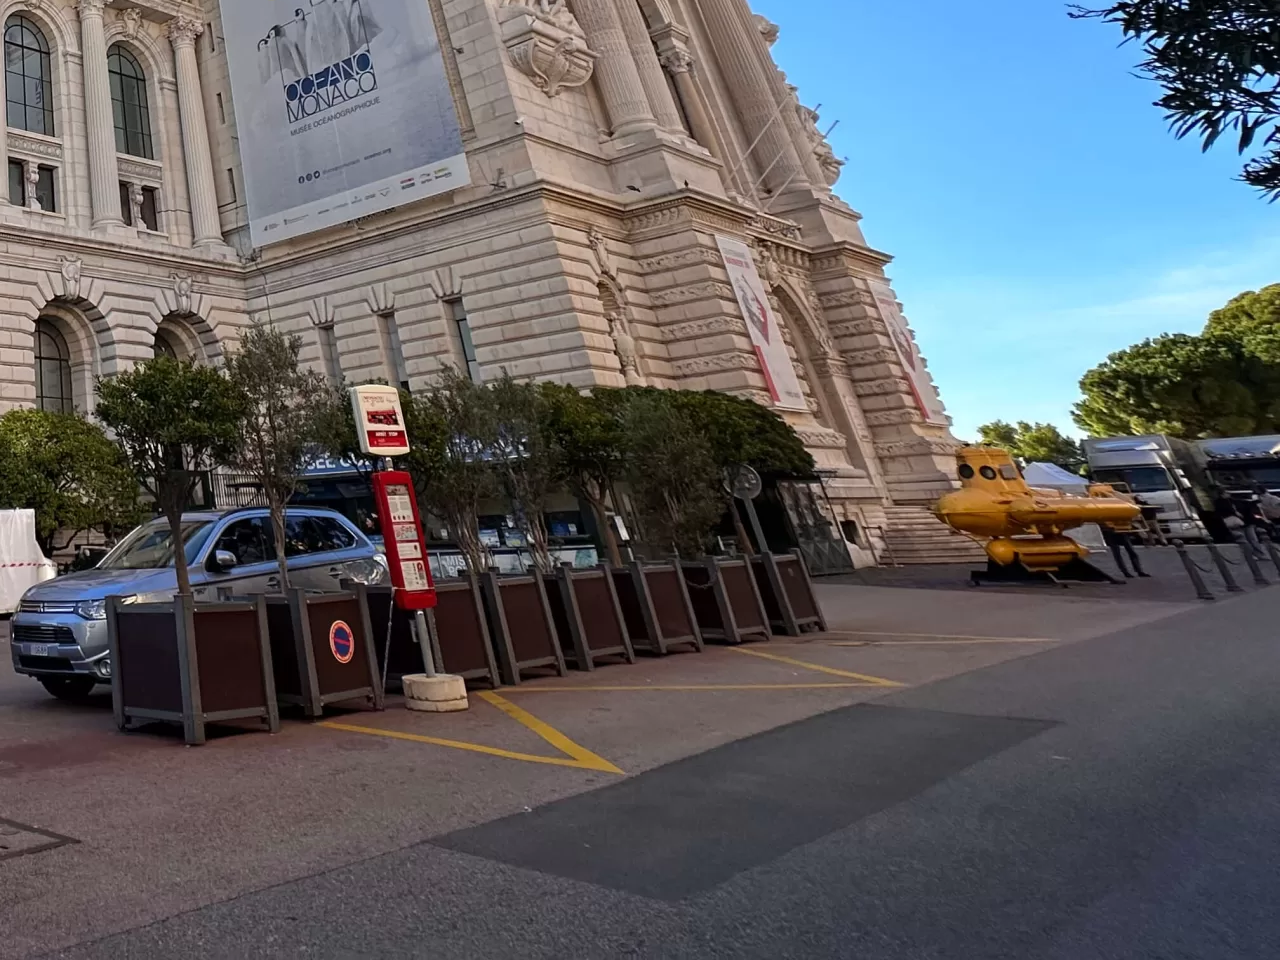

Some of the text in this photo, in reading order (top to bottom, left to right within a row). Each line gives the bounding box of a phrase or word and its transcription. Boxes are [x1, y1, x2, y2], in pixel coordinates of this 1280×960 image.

[284, 51, 373, 102] OCEANO
[286, 71, 377, 124] MONACO
[290, 96, 381, 137] MUSÉE OCÉANOGRAPHIQUE
